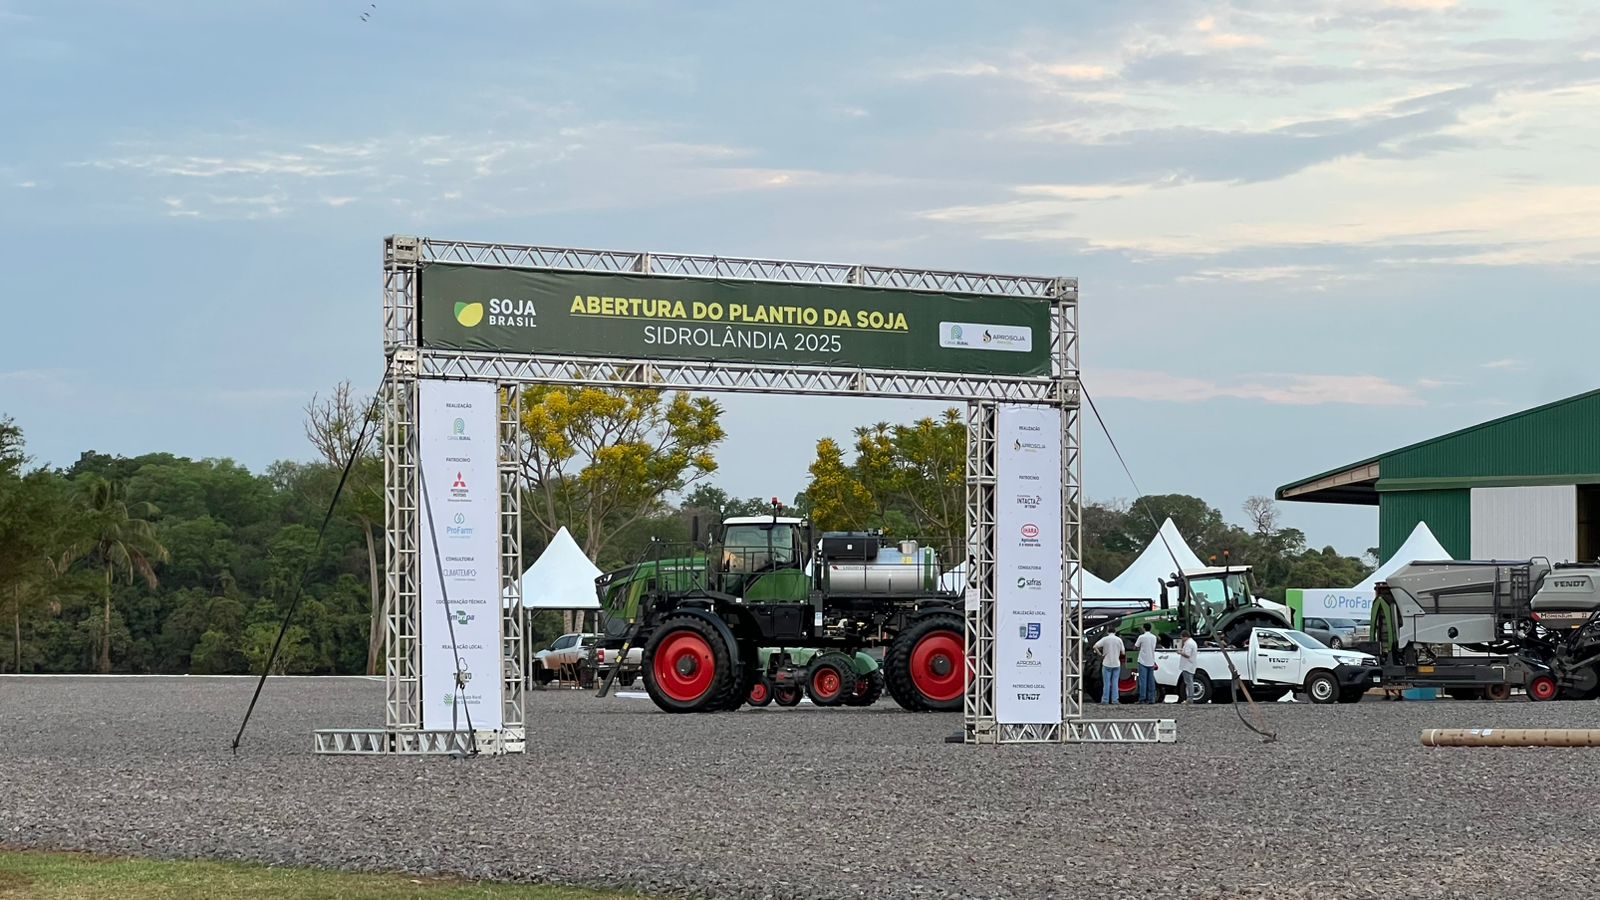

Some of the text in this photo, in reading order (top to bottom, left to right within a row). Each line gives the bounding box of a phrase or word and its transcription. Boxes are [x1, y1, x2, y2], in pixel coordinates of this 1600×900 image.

[489, 298, 536, 316] SOJA
[570, 295, 908, 330] ABERTURA DO PLANTIO DA SOJA
[489, 315, 536, 328] BRASIL
[643, 325, 842, 353] SIDROLÂNDIA 2025
[446, 526, 473, 534] ProFarm
[1554, 580, 1587, 588] FENDT
[1338, 595, 1373, 609] ProFar
[1017, 693, 1041, 701] FENDT
